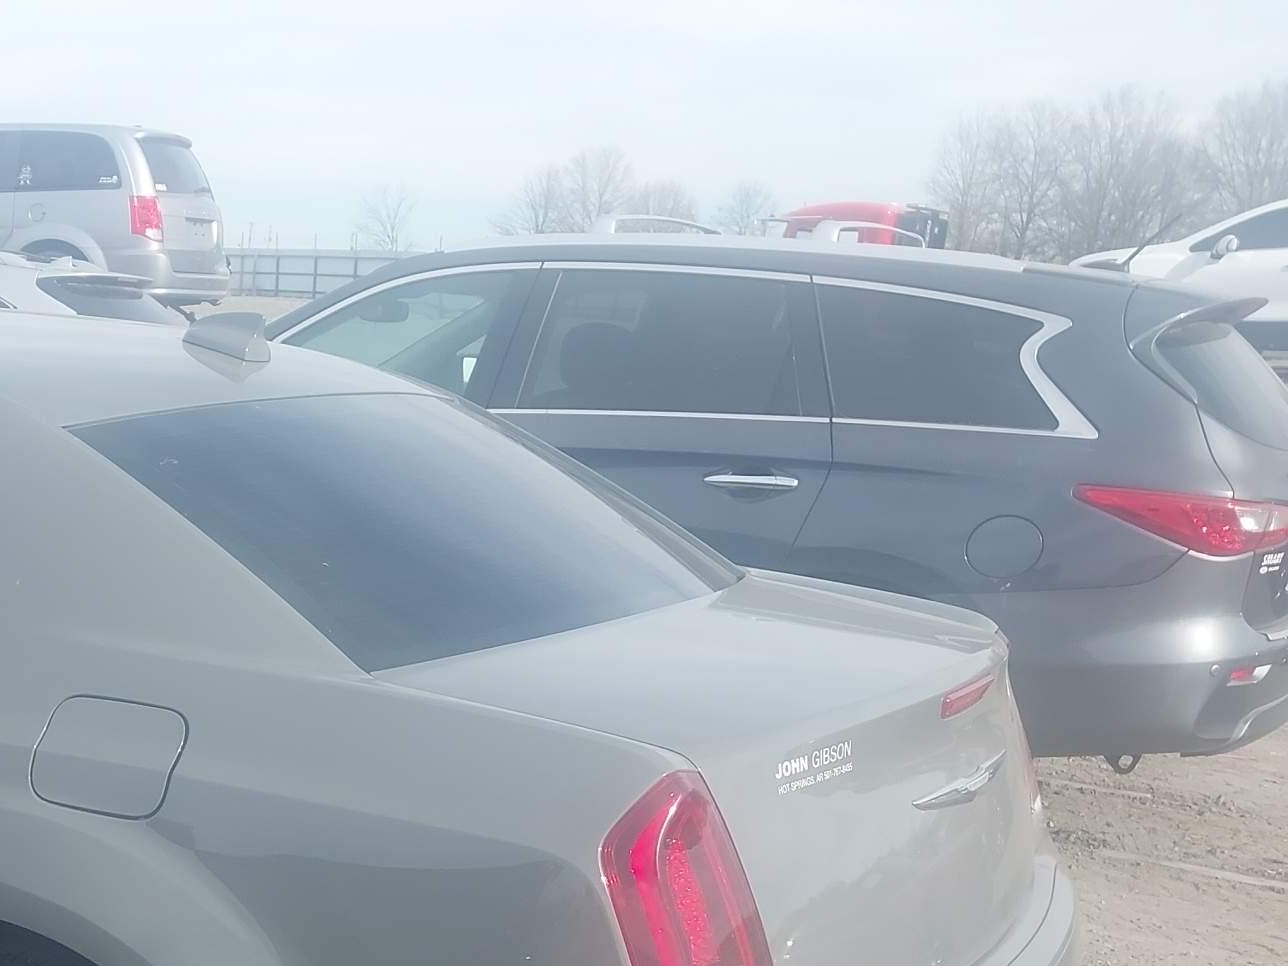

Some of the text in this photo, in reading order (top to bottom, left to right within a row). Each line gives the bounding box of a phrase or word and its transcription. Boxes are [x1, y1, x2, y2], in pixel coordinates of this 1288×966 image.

[775, 740, 852, 779] JOHN GIBSON
[778, 783, 790, 795] HOT
